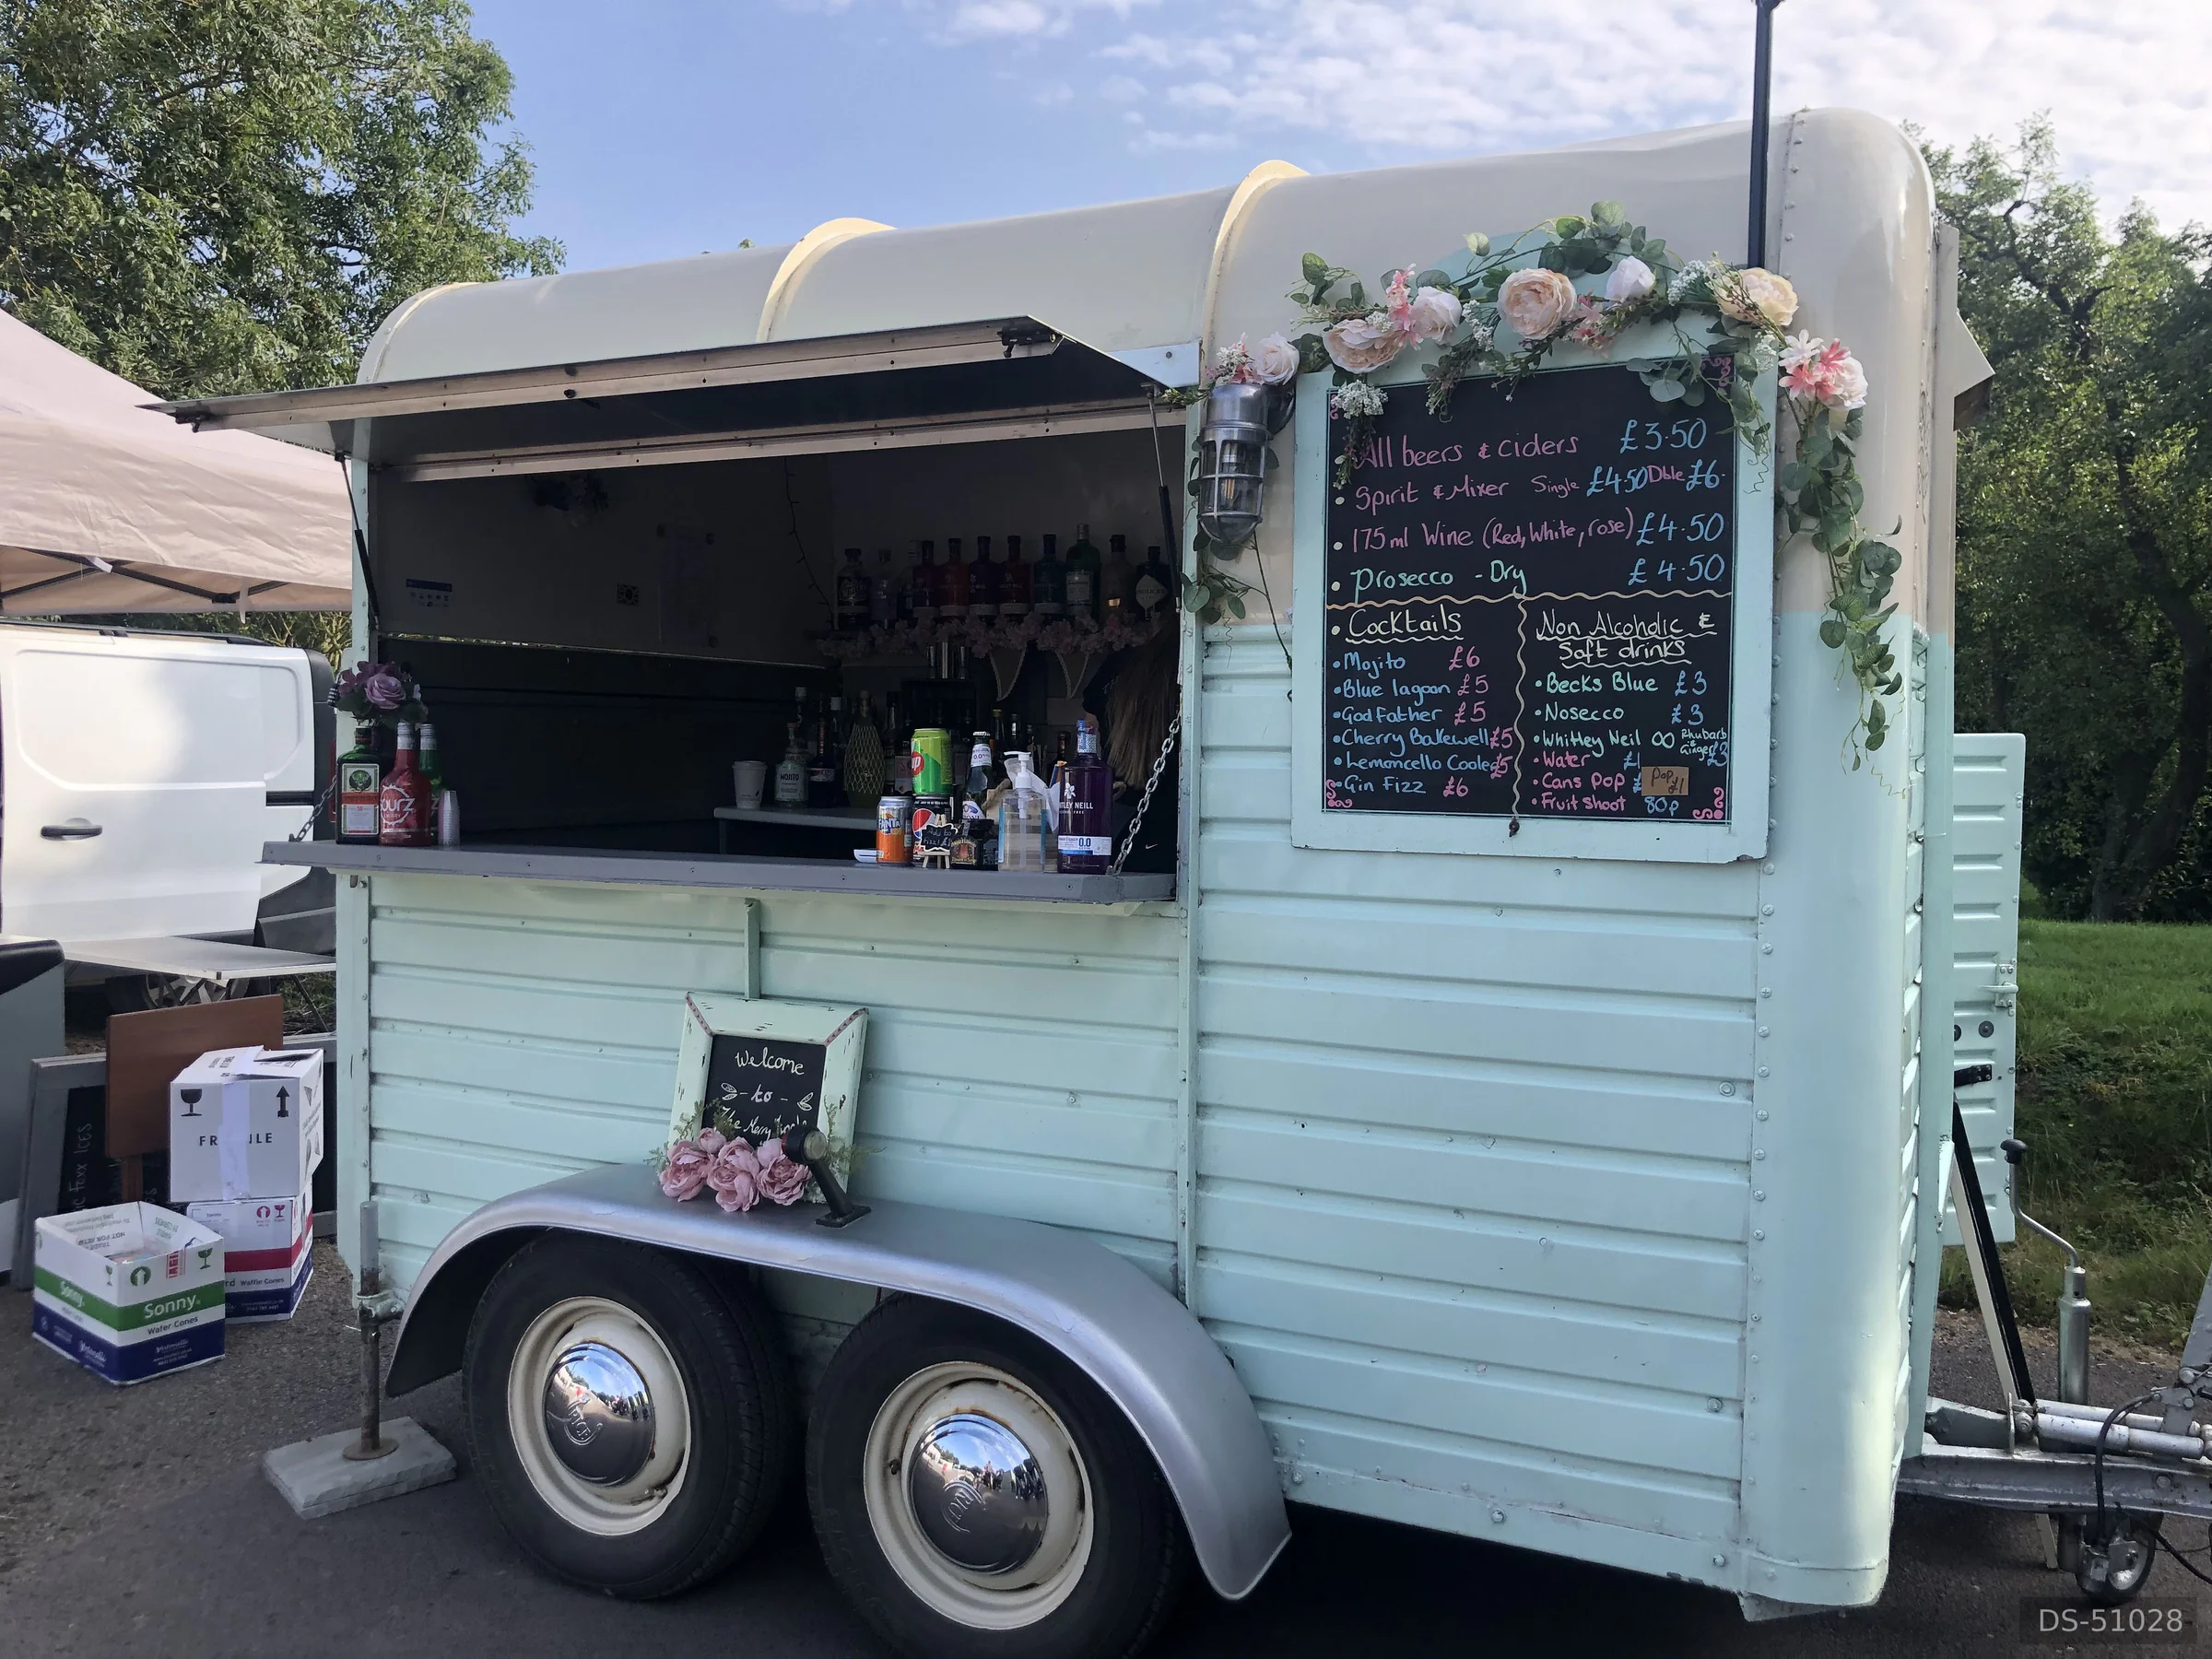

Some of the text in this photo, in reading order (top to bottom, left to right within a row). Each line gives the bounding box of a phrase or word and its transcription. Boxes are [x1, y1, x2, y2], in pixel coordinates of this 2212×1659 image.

[1354, 435, 1393, 469] All
[1402, 441, 1464, 467] beers
[1619, 418, 1708, 455] £3.50
[1355, 482, 1419, 516] Spirit
[1445, 473, 1510, 500] Mixer
[1531, 474, 1582, 500] Single
[1586, 465, 1648, 497] £4.50
[1422, 521, 1475, 547] Wine
[1635, 511, 1725, 547] £4.50
[1490, 559, 1528, 599] Dry
[1629, 553, 1725, 587] £4.50
[1536, 608, 1581, 636] Non
[1589, 610, 1684, 636] Alcoholic
[1344, 645, 1481, 679] Mojito £6
[1559, 638, 1609, 664] Soft
[1343, 673, 1489, 706] Blue lagoon £5
[1612, 670, 1660, 693] Blue
[1674, 669, 1708, 697] £3
[1454, 700, 1487, 726] £5
[1545, 701, 1705, 726] Nosecco £3
[1342, 728, 1406, 758] Cherry
[1489, 725, 1514, 750] £5
[1542, 731, 1606, 758] Whitley
[1609, 729, 1642, 747] Neil
[1681, 727, 1728, 740] Rhubarb
[1489, 752, 1514, 780] £5
[1542, 750, 1642, 771] Water £1
[1706, 741, 1730, 768] £3
[780, 773, 800, 782] MOJITO
[1344, 774, 1469, 798] Gin Fizz £6
[1541, 772, 1583, 790] Cans
[1075, 801, 1094, 810] NEILL
[1541, 791, 1580, 812] Fruit
[1643, 795, 1680, 817] 80p
[878, 818, 901, 830] FANTA
[1078, 837, 1091, 848] 0.0
[735, 1046, 805, 1076] Welcome
[751, 1083, 773, 1103] to
[199, 1132, 273, 1147] FRILE
[144, 1294, 196, 1320] Sonny
[147, 1316, 199, 1335] Wafer Cones
